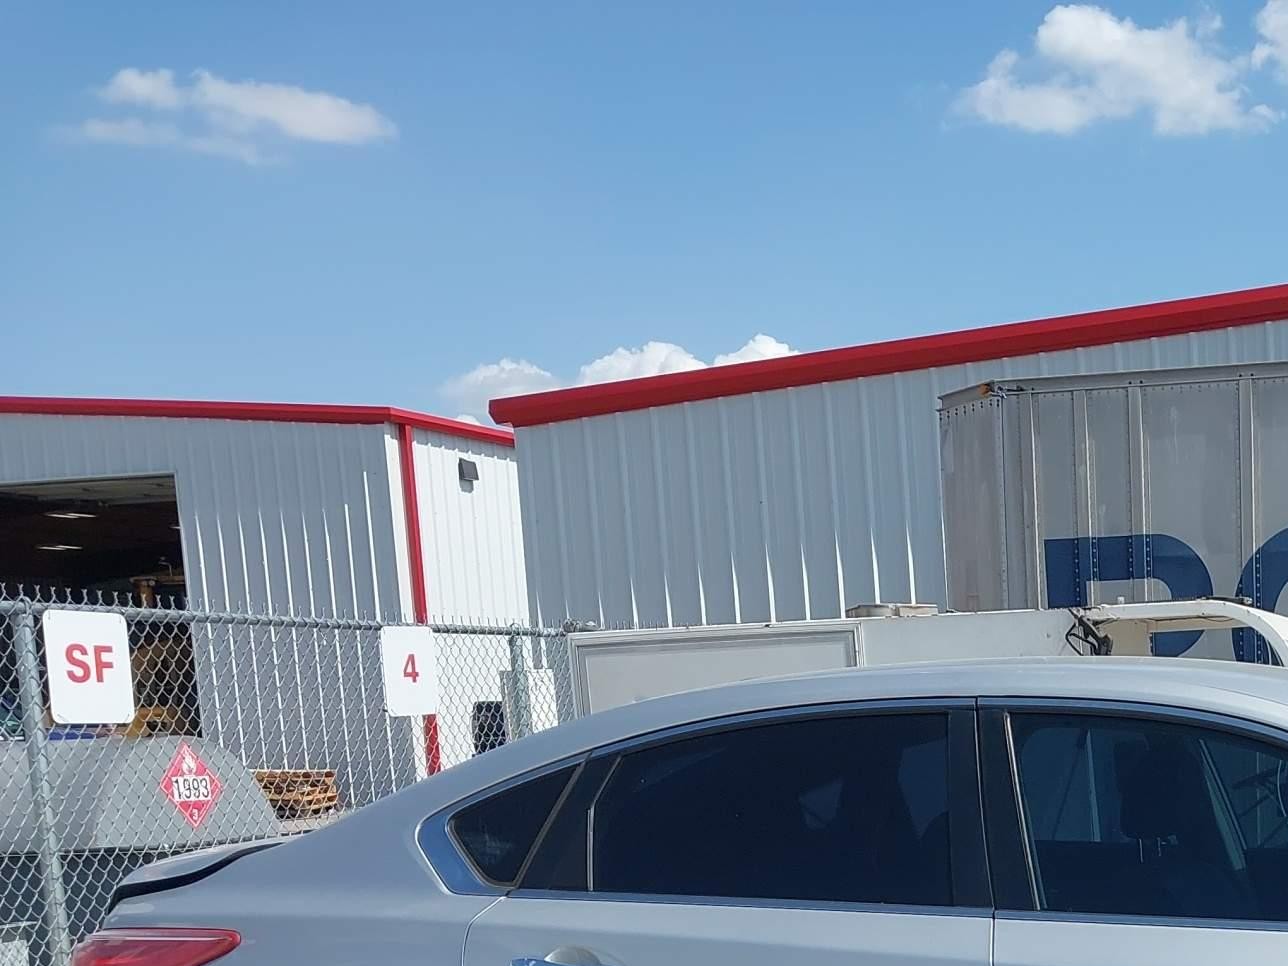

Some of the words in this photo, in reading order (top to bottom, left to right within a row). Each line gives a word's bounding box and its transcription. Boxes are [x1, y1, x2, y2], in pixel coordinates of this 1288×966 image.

[64, 643, 114, 684] SF
[403, 653, 419, 683] 4
[173, 777, 210, 800] 1993
[191, 808, 199, 821] 3
